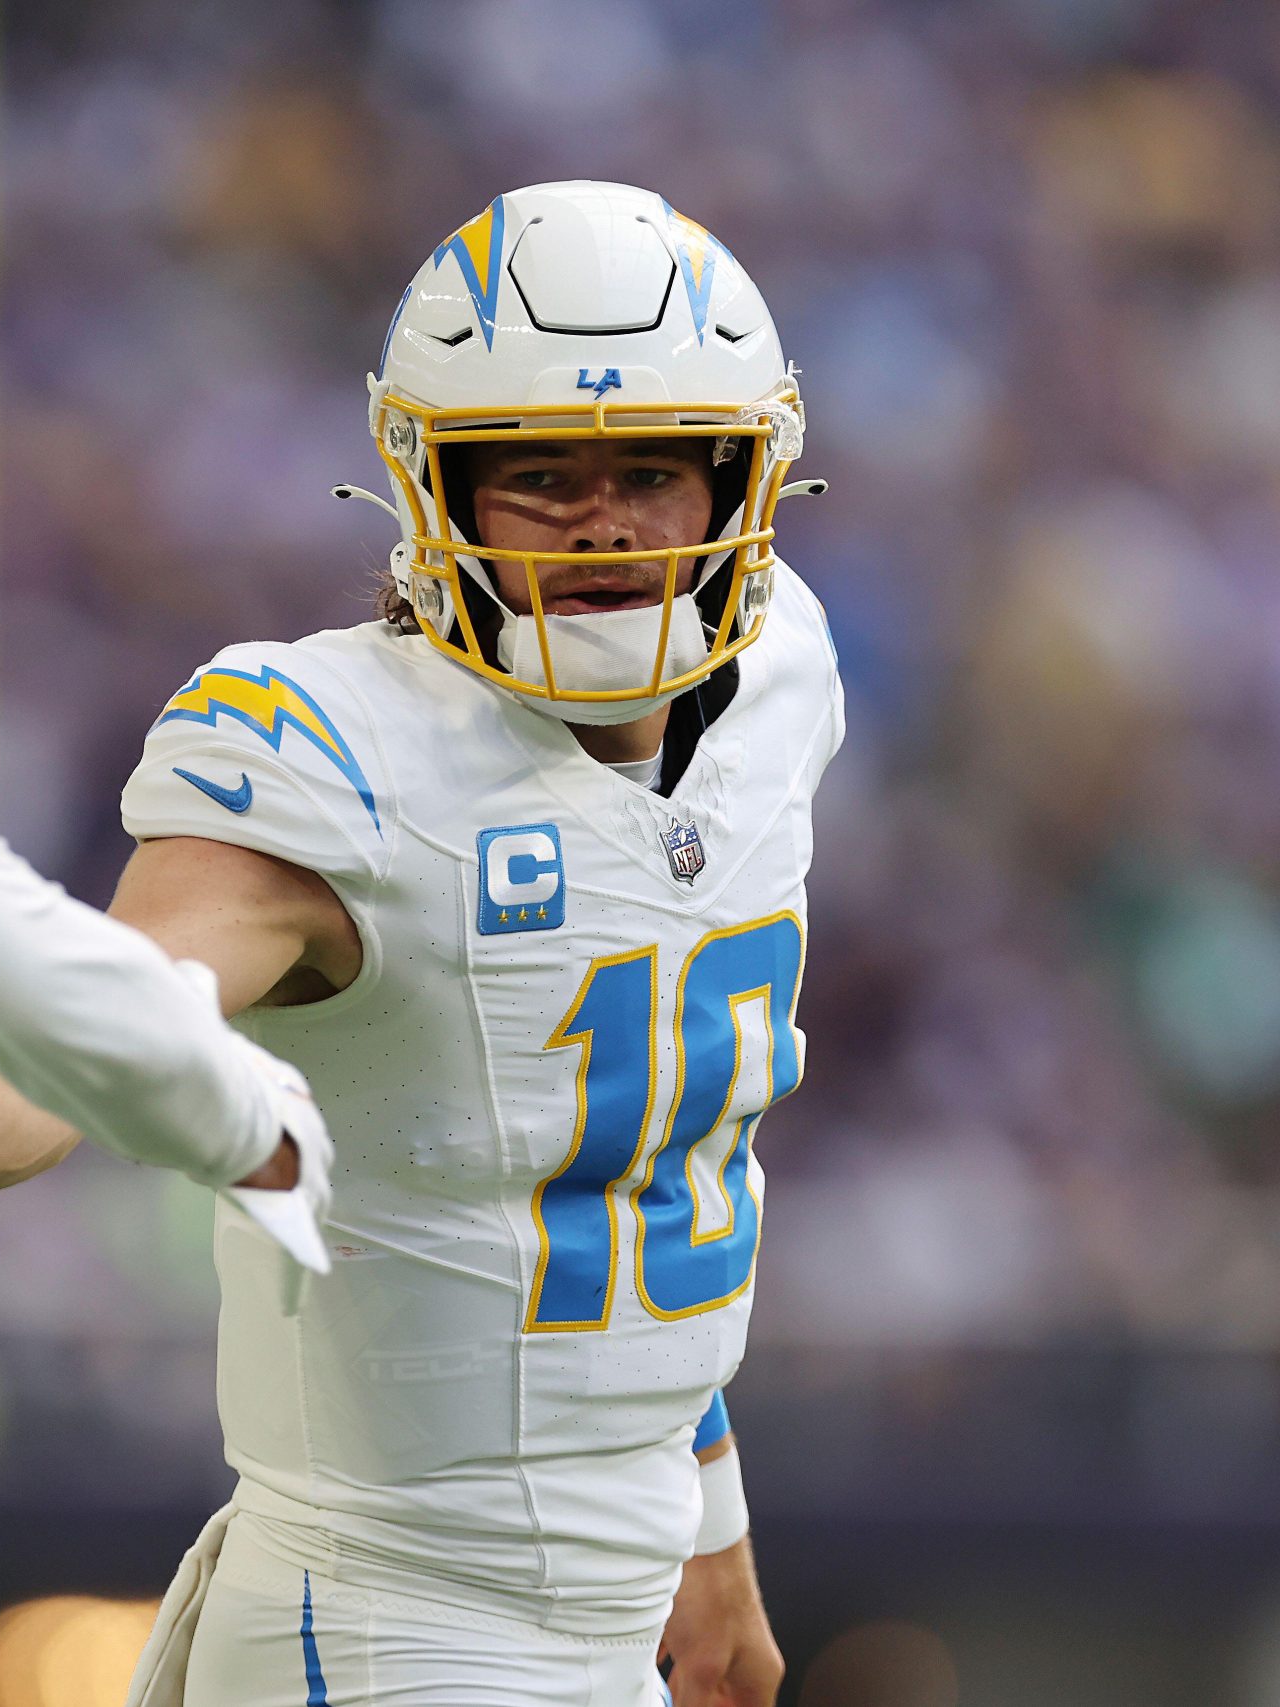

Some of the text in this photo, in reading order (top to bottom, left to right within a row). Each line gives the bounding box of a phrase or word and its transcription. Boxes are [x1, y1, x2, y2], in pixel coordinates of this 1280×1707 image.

[576, 368, 622, 400] LA
[487, 832, 559, 906] C
[675, 846, 702, 873] NFL
[523, 908, 806, 1333] 10
